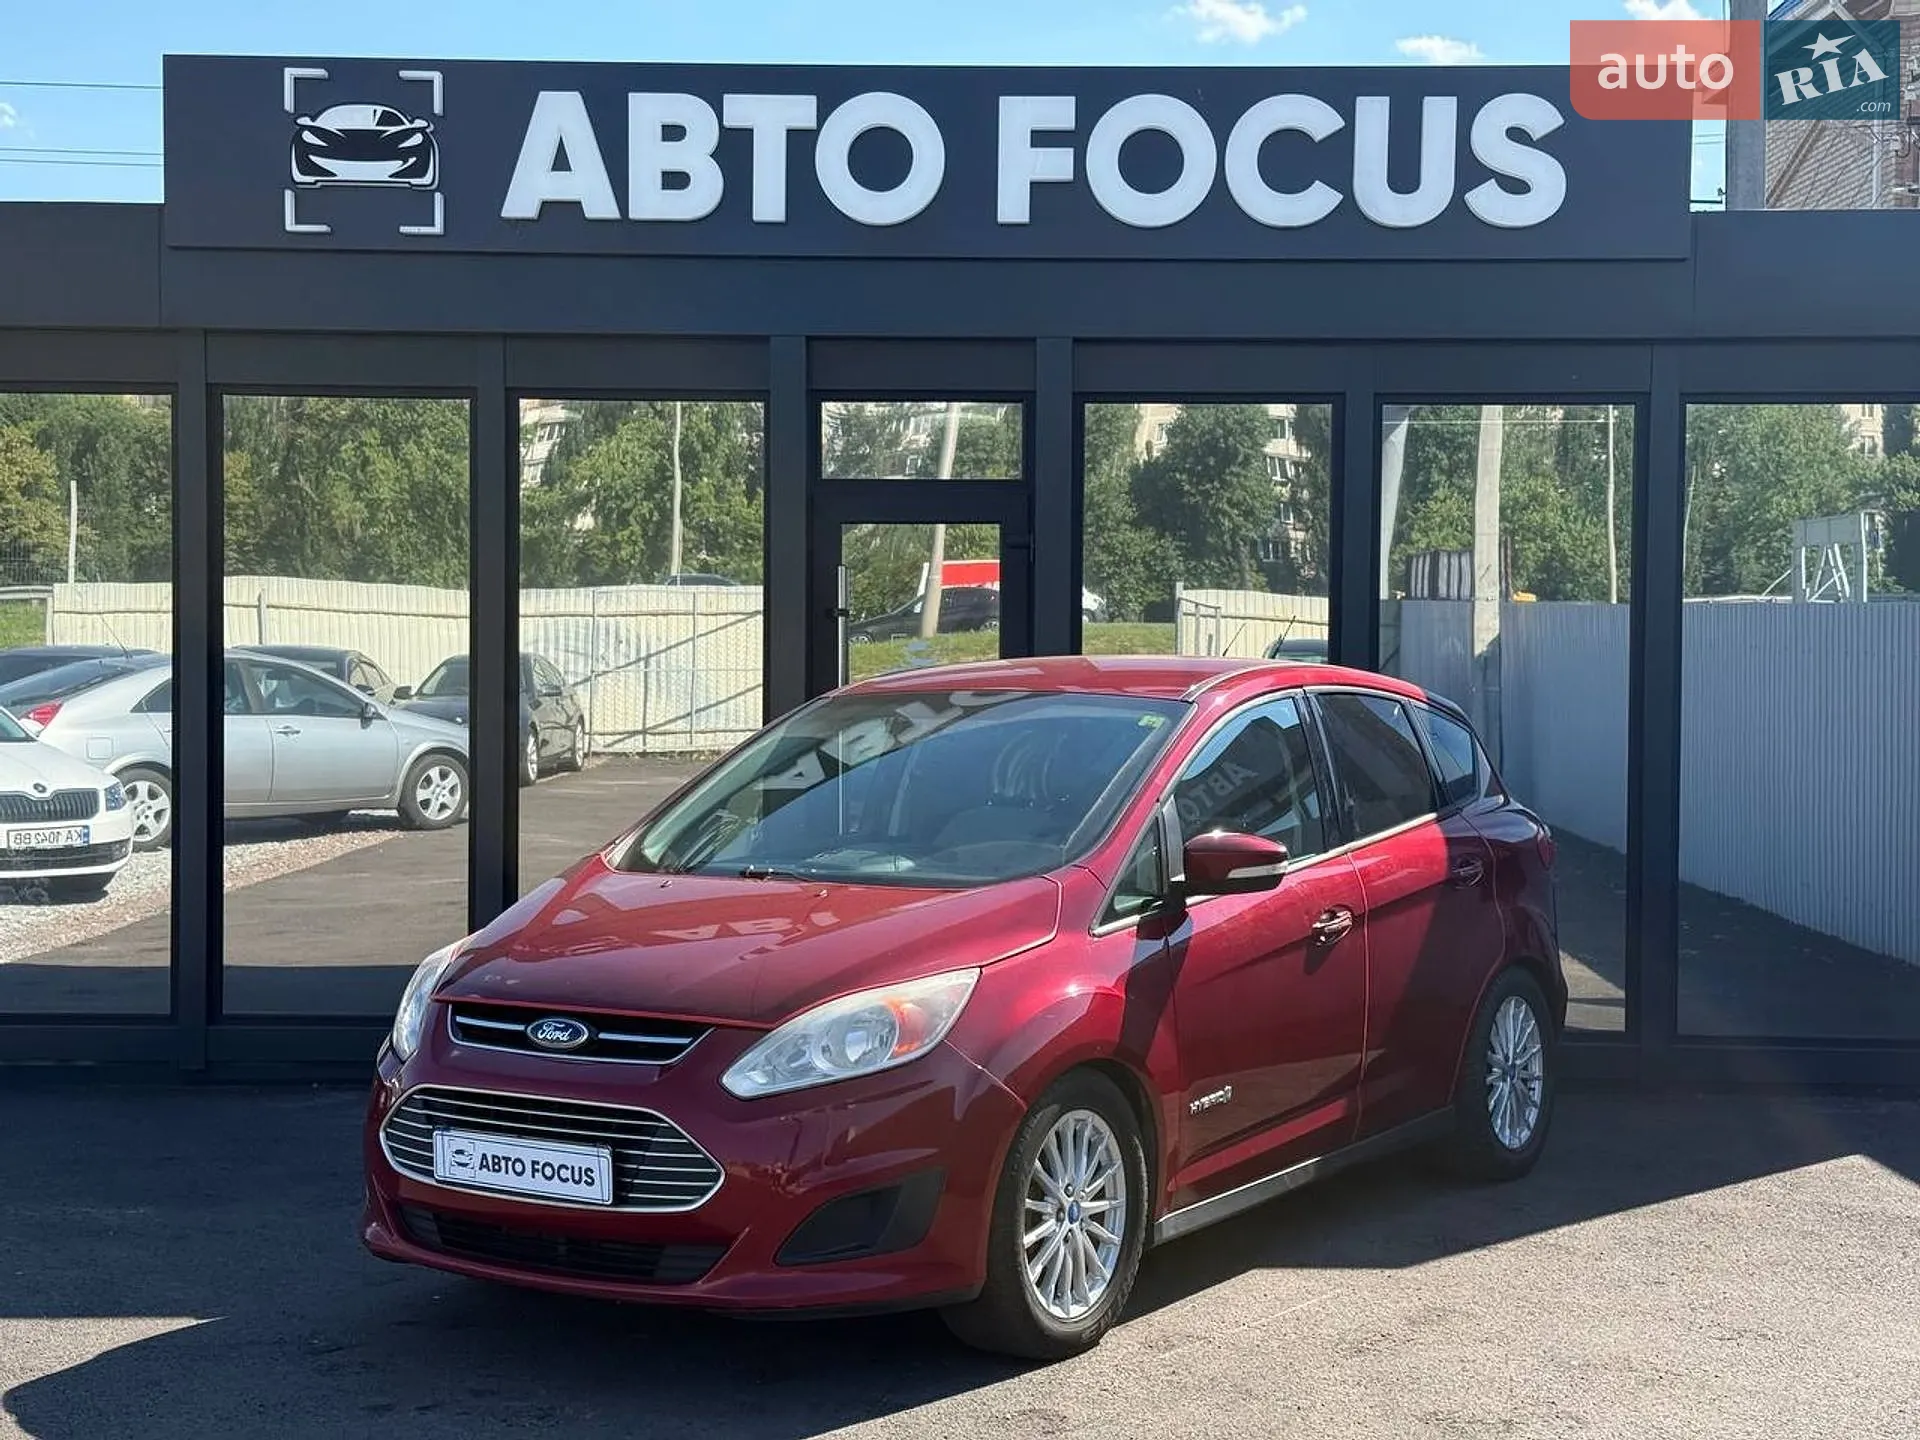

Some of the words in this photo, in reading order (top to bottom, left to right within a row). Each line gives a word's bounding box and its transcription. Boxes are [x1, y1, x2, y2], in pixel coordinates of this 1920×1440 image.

[501, 90, 946, 226] АВТО
[997, 93, 1567, 229] FOCUS
[537, 1021, 573, 1041] Ford
[478, 1153, 526, 1177] АВТО
[531, 1160, 596, 1187] FOCUS
